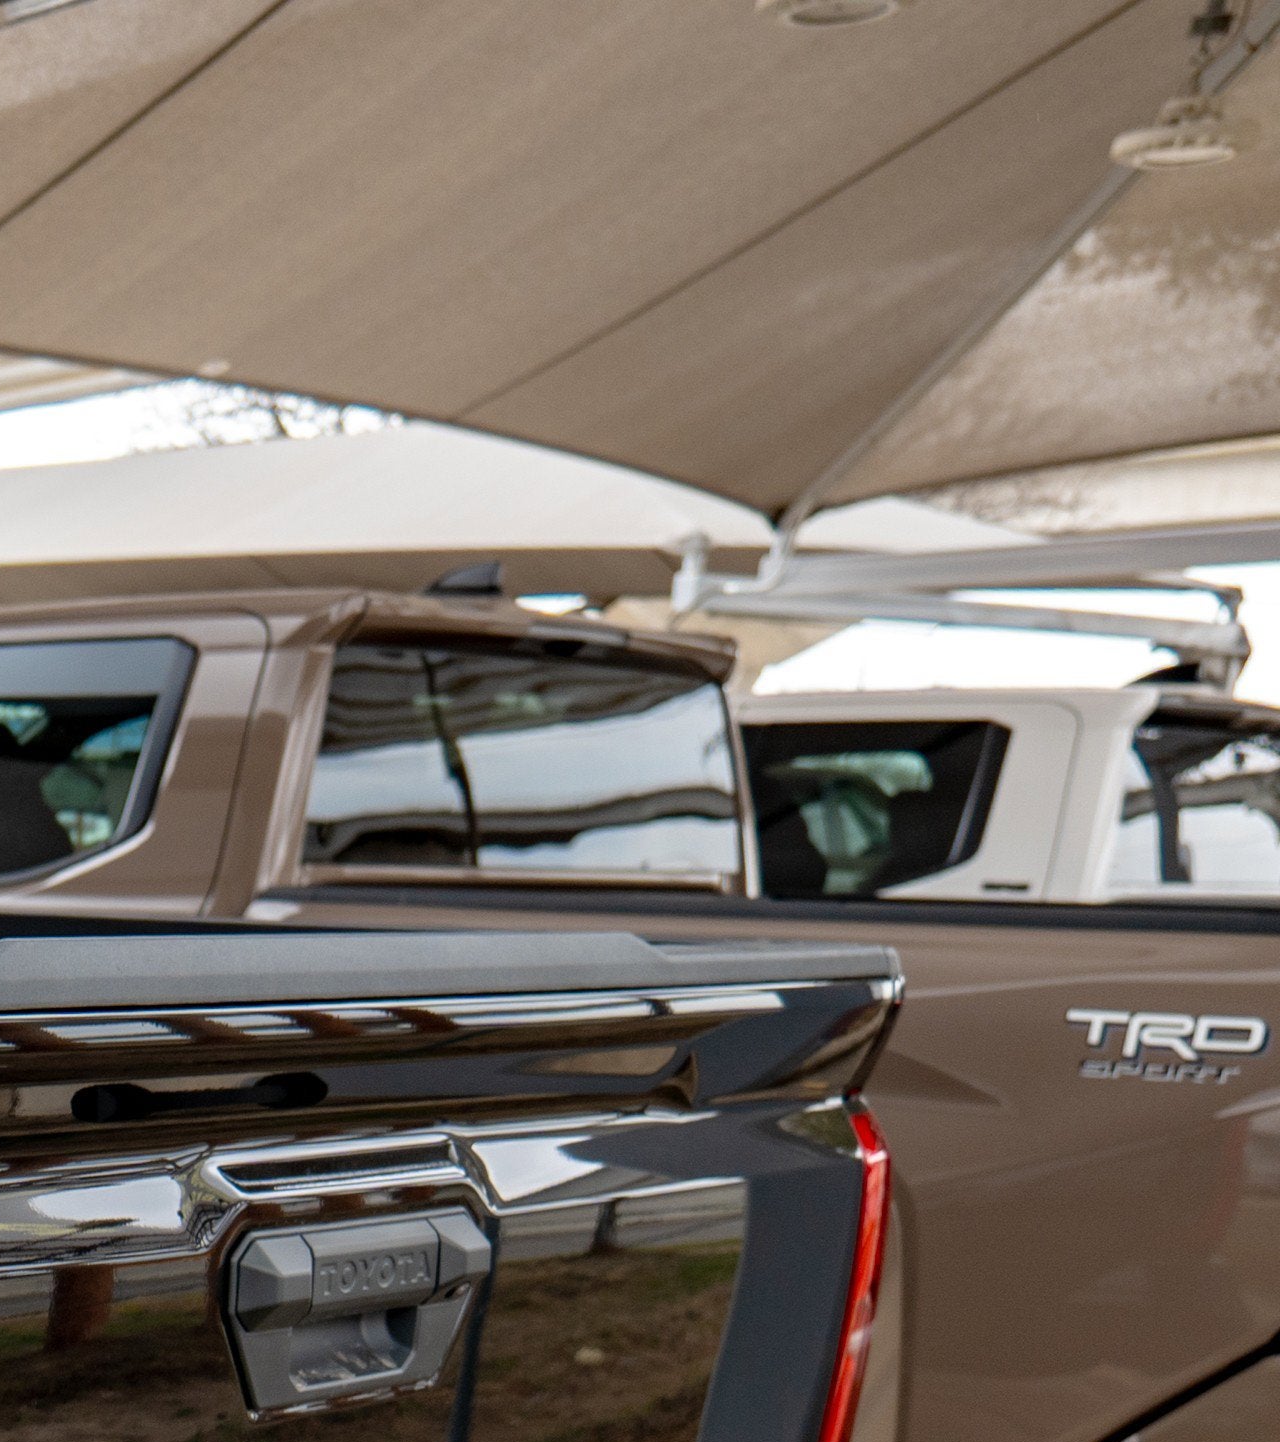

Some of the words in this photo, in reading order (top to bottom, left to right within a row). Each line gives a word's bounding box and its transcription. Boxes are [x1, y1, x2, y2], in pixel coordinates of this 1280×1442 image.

[1066, 1008, 1267, 1061] TRD
[1078, 1059, 1241, 1085] SPORT
[320, 1251, 432, 1297] TOYOTA
